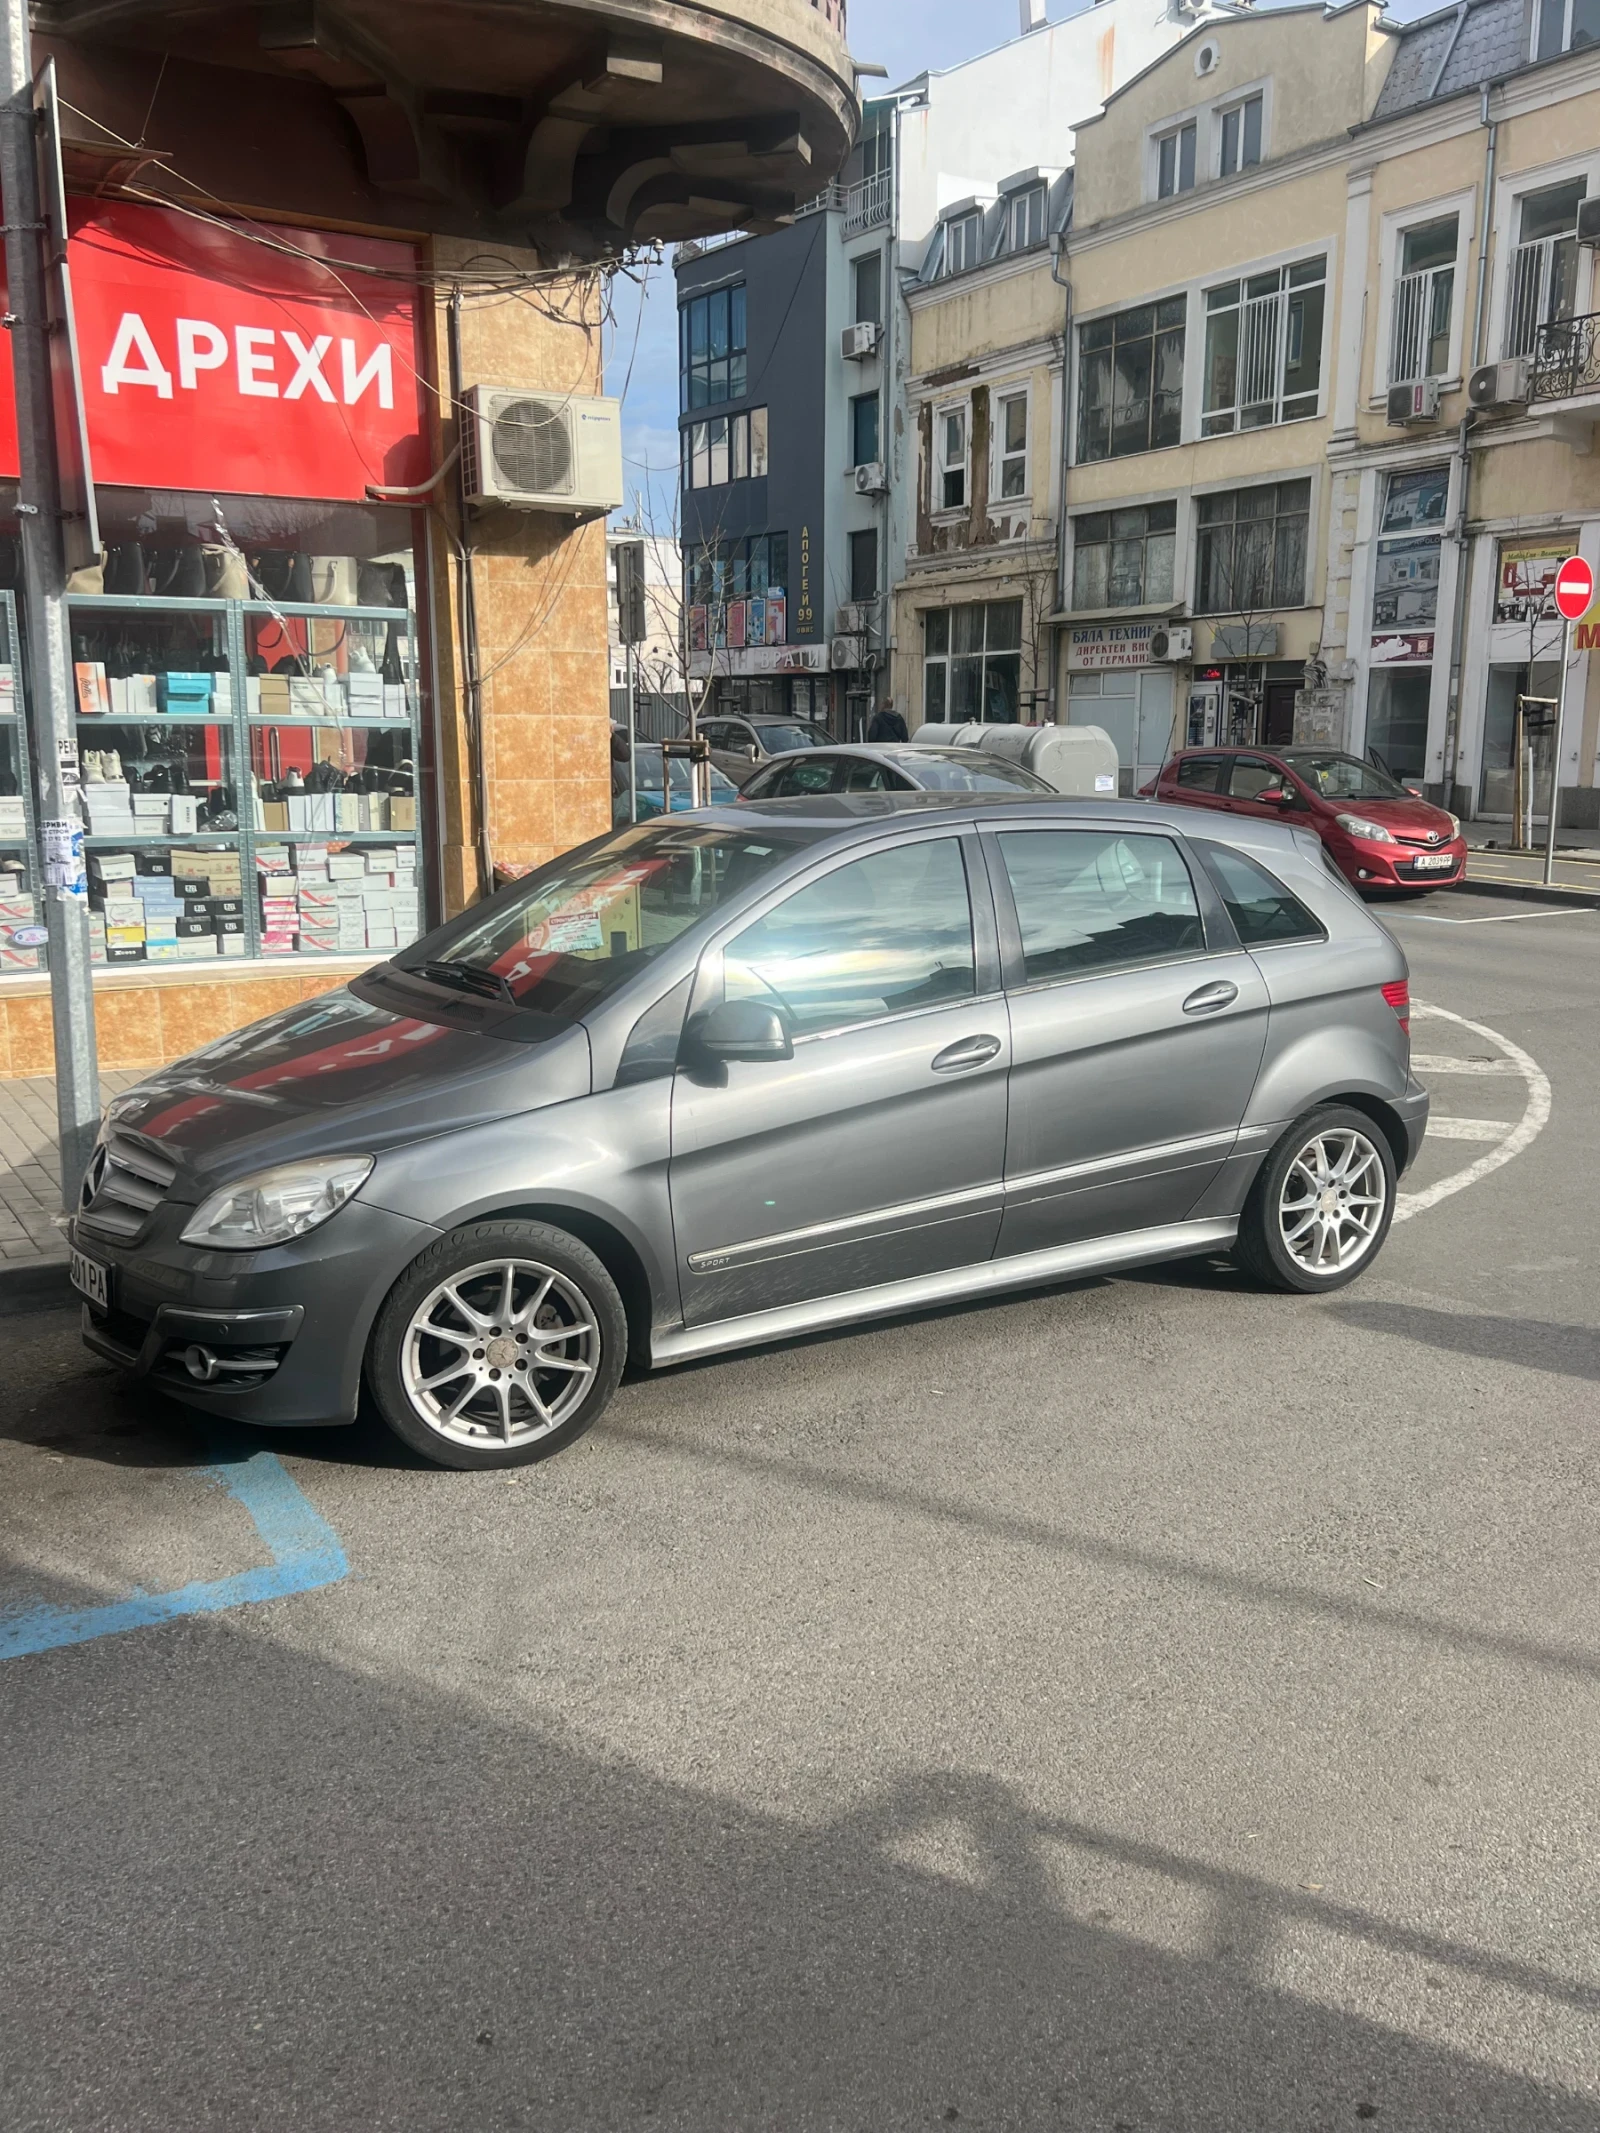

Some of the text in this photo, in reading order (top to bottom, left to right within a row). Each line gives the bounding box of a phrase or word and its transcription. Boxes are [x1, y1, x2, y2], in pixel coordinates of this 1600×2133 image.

[101, 312, 394, 410] ДРЕХИ
[801, 526, 809, 606] АПОГЕЙ
[798, 608, 812, 621] 99
[1073, 625, 1162, 643] БЯЛА ТЕХНИК
[1076, 643, 1126, 656] ДИРЕКТЕН
[760, 649, 820, 669] ВРАТИ
[1083, 657, 1094, 666] ОТ
[701, 1257, 730, 1268] SPORT
